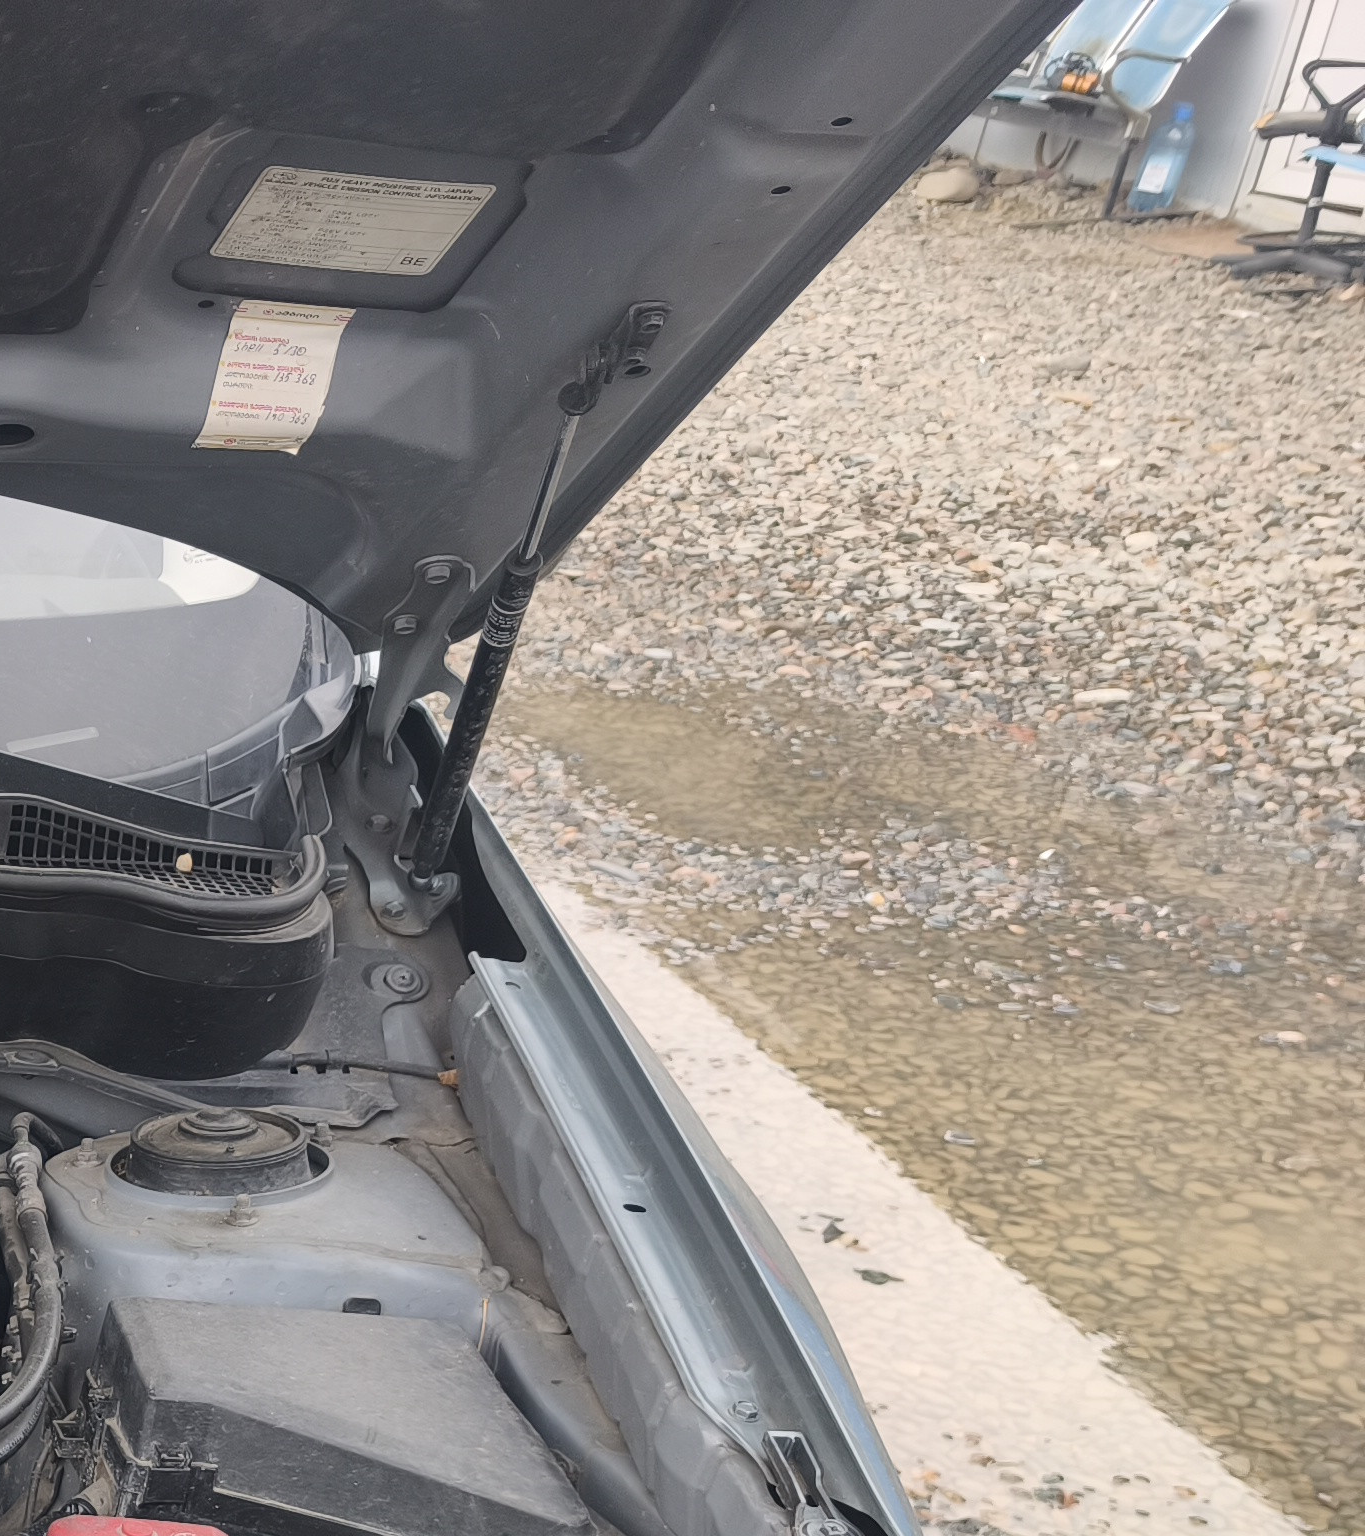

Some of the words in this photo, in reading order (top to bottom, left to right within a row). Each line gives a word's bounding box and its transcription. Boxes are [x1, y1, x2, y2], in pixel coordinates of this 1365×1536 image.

[303, 181, 339, 190] VEHICLE
[340, 185, 380, 195] EMISSION
[382, 189, 421, 199] CONTROL
[424, 193, 483, 202] INFORMATION
[321, 176, 340, 184] FUJI
[341, 179, 370, 187] HEAVY
[444, 187, 474, 195] JAPAN
[400, 256, 428, 267] BE
[295, 373, 317, 386] 368
